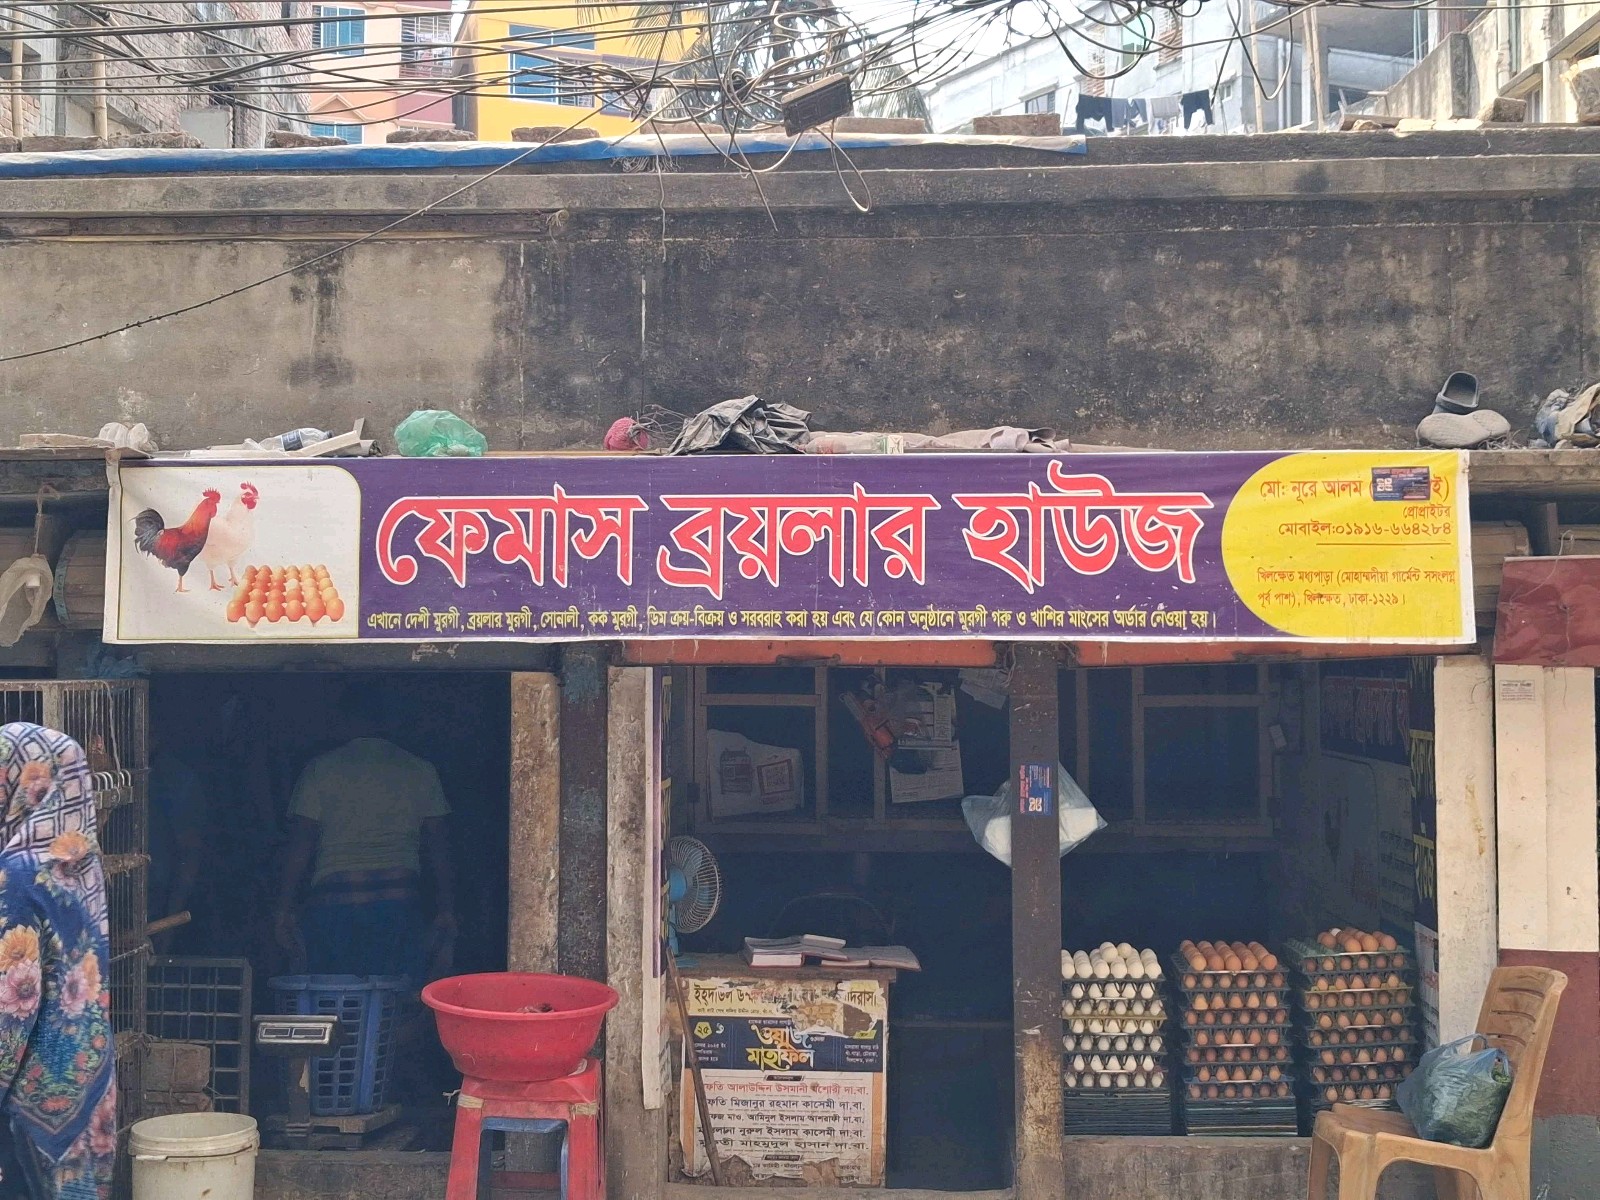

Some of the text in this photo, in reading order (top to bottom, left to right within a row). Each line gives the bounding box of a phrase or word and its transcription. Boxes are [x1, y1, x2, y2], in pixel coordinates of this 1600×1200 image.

[1290, 479, 1317, 504] নূরে
[1322, 479, 1363, 498] আলম
[1402, 505, 1451, 520] প্রোপ্রাইটর
[376, 459, 1215, 600] ফেমাস ব্রয়লার হাউজ
[1297, 570, 1334, 586] মধ্যপাড়া
[1257, 589, 1272, 609] পূর্ব
[367, 612, 402, 629] এখানে
[405, 606, 430, 629] দেশী
[467, 611, 503, 631] ব্রয়লার
[588, 611, 608, 629] কক
[648, 606, 667, 628] ডিম
[670, 606, 725, 629] ক্রয়-বিক্রয়
[728, 609, 738, 627] ও
[741, 610, 782, 629] সরবরাহ
[786, 609, 807, 628] করা
[811, 609, 829, 629] হয়
[832, 609, 856, 629] এবং
[859, 609, 873, 628] যে
[876, 609, 905, 628] কোন
[909, 604, 954, 630] অনুষ্ঠানে
[958, 605, 987, 631] মুরগী
[991, 609, 1012, 629] গরু
[1015, 610, 1027, 627] ও
[1030, 604, 1065, 628] খাশির
[1067, 609, 1110, 628] মাংসের
[1113, 604, 1147, 628] অর্ডার
[1150, 609, 1188, 630] নেওয়া
